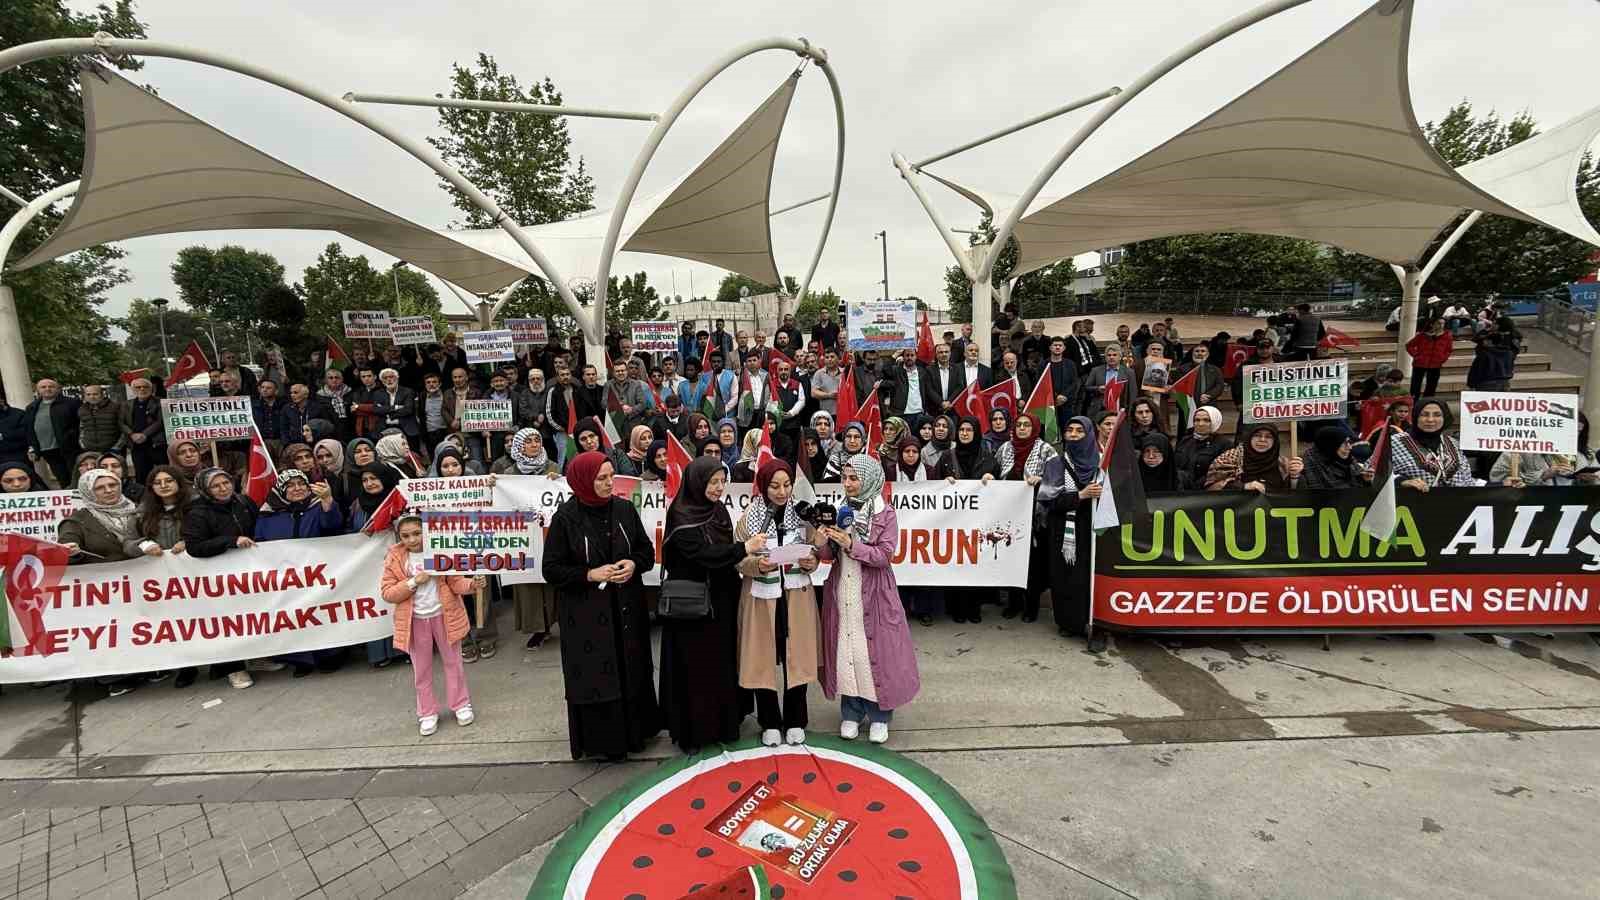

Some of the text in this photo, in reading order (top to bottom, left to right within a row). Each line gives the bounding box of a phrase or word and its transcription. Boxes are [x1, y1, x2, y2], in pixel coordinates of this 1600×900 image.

[1251, 362, 1341, 383] FİLİSTİNLİ
[1251, 383, 1341, 401] BEBEKLER
[1253, 400, 1338, 419] ÖLMESİN!
[1490, 396, 1548, 412] KUDÜS
[171, 413, 248, 427] BEBEKLER
[464, 412, 509, 420] BEBEKLER
[1474, 415, 1564, 428] ÖZGÜR DEĞİLSE
[1499, 427, 1537, 439] DÜNYA
[1477, 438, 1559, 453] TUTSAKTIR.
[407, 480, 445, 492] SESSİZ
[432, 491, 459, 501] savaş
[462, 489, 484, 499] değil
[943, 491, 979, 510] DİYE
[430, 535, 530, 549] FİLİSTİN'DEN
[1121, 505, 1426, 561] UNUTMA
[432, 551, 526, 572] DEFOL!
[143, 562, 337, 602] SAVUNMAK,
[1110, 581, 1588, 615] GAZZE'DE ÖLDÜRÜLEN SENİN
[131, 596, 388, 647] SAVUNMAKTIR.
[718, 785, 771, 837] BOYKOT ET
[788, 847, 806, 866] BU
[799, 819, 849, 879] ORTAK OLMA
